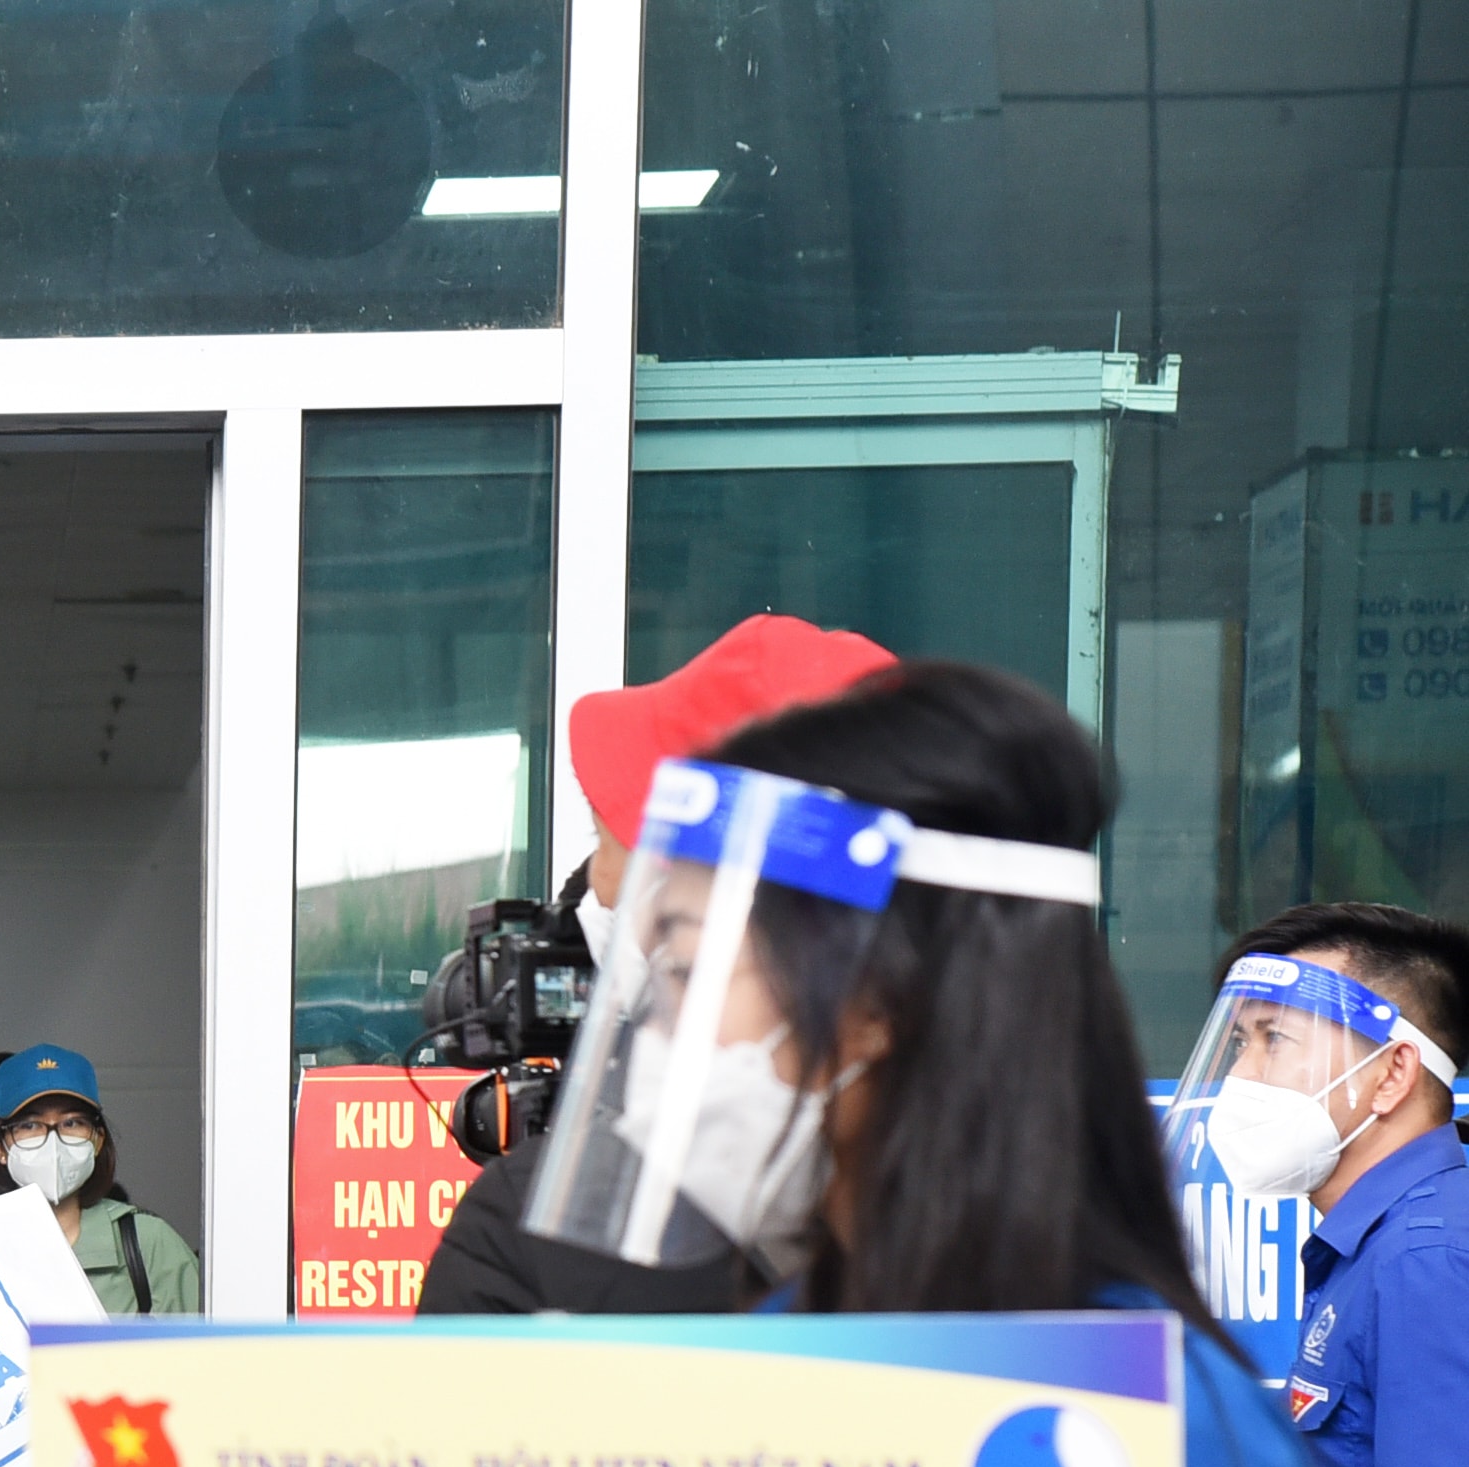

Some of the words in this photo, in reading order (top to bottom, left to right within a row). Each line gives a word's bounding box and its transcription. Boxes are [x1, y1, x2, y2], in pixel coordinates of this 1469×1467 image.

[1237, 960, 1286, 980] Shield
[335, 1101, 415, 1149] KHU
[334, 1180, 416, 1239] HẠN
[301, 1259, 433, 1308] RESTR
